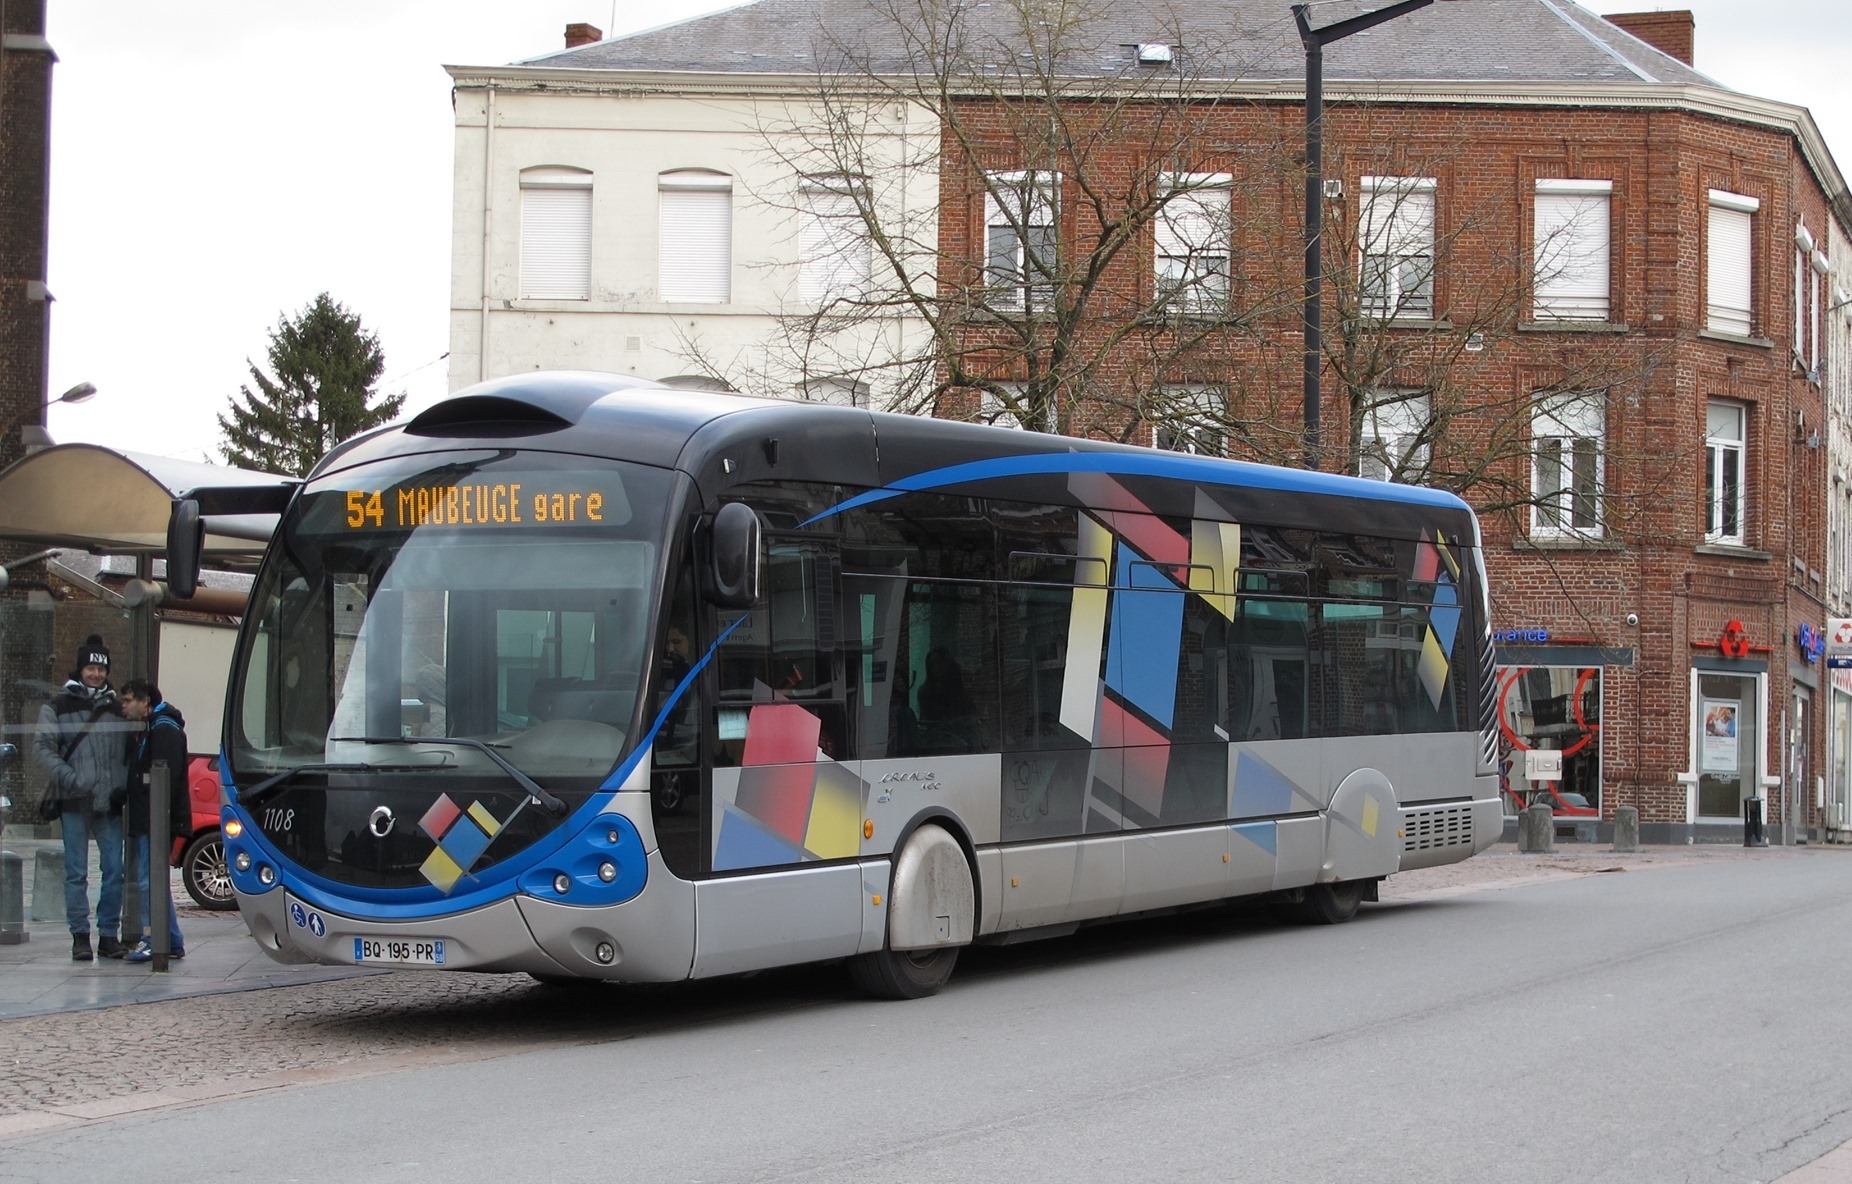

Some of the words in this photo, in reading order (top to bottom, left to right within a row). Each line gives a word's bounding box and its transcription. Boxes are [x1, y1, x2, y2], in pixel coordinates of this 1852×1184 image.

[346, 490, 385, 528] 54
[398, 484, 522, 526] MAUBEUGE
[534, 492, 603, 522] gare
[93, 653, 108, 664] NY
[263, 808, 296, 832] 1108
[363, 940, 434, 961] BQ-195-PR
